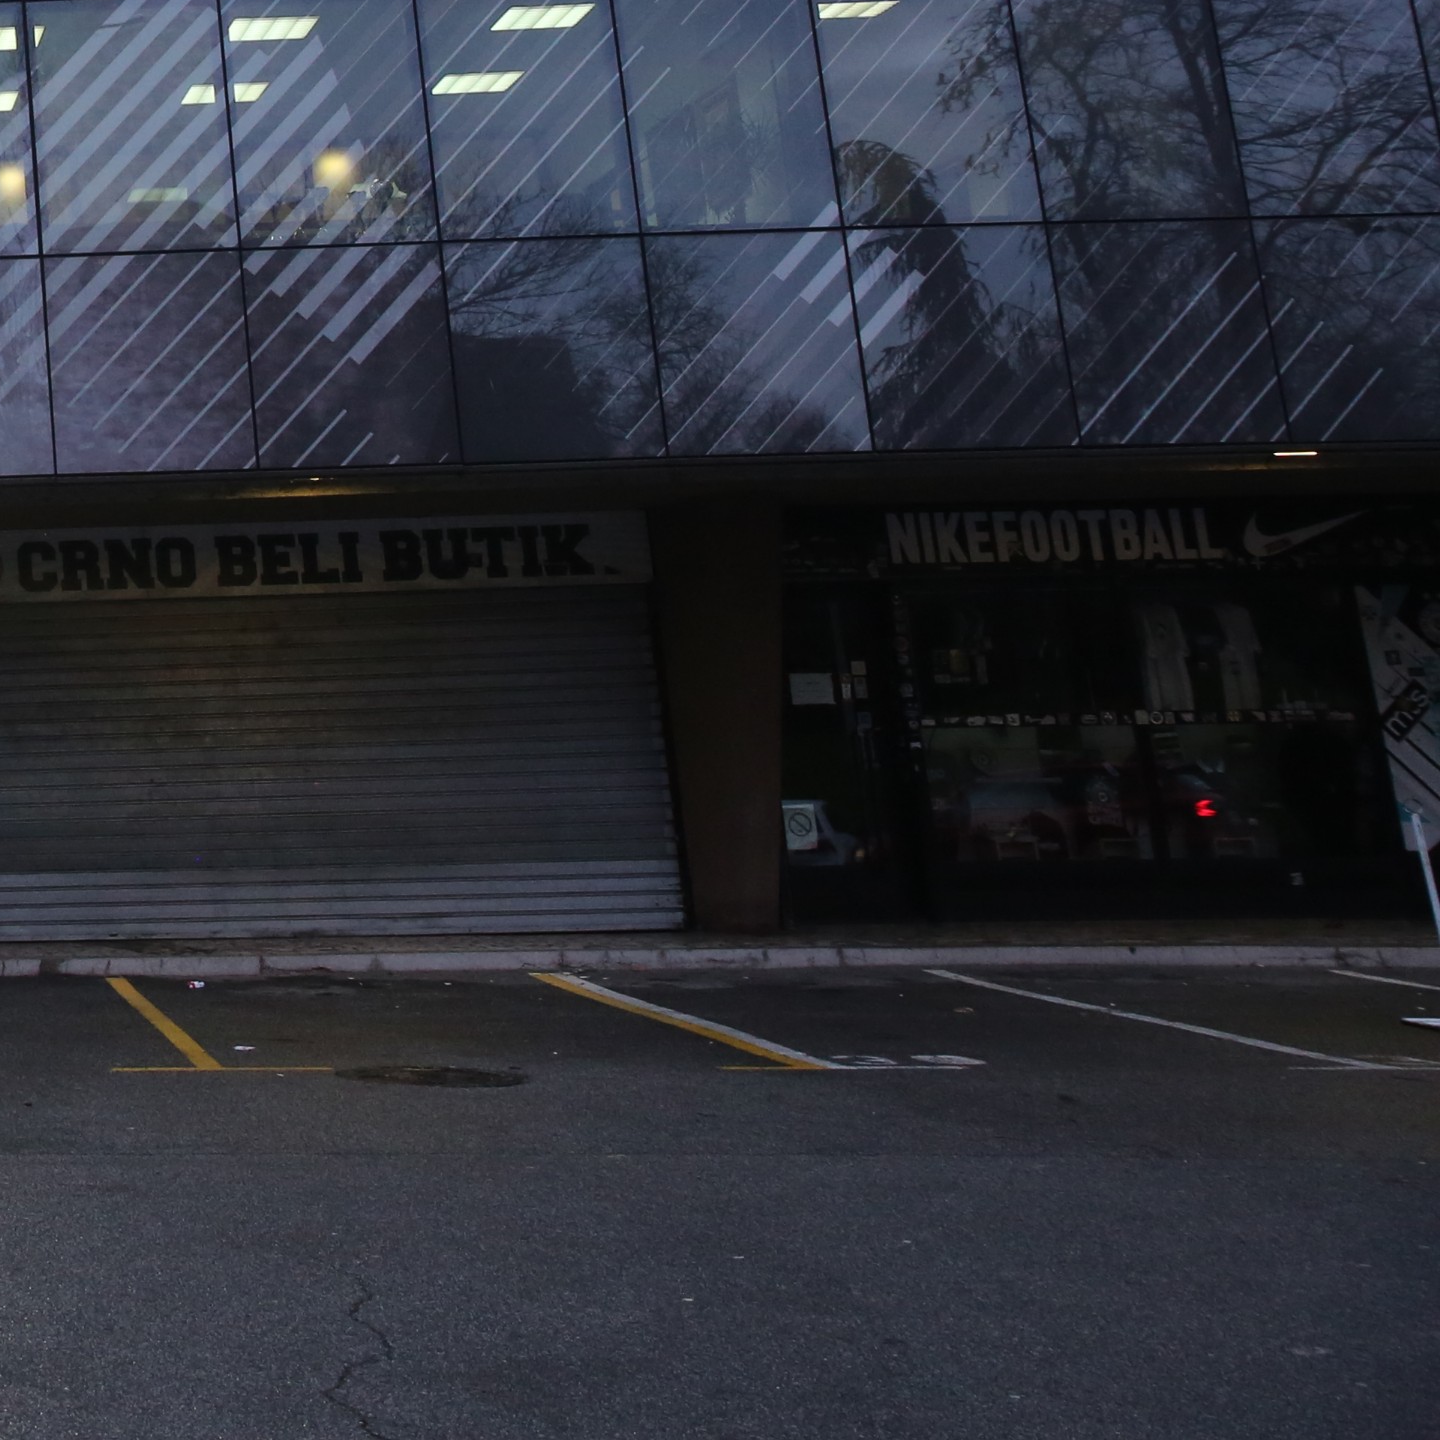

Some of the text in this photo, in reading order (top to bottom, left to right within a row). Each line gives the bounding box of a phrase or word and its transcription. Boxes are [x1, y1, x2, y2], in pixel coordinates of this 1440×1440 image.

[17, 537, 198, 593] CRNO
[214, 530, 364, 587] BELI
[378, 523, 596, 581] BUTIK
[884, 508, 1226, 565] NIKEFOOTBALL
